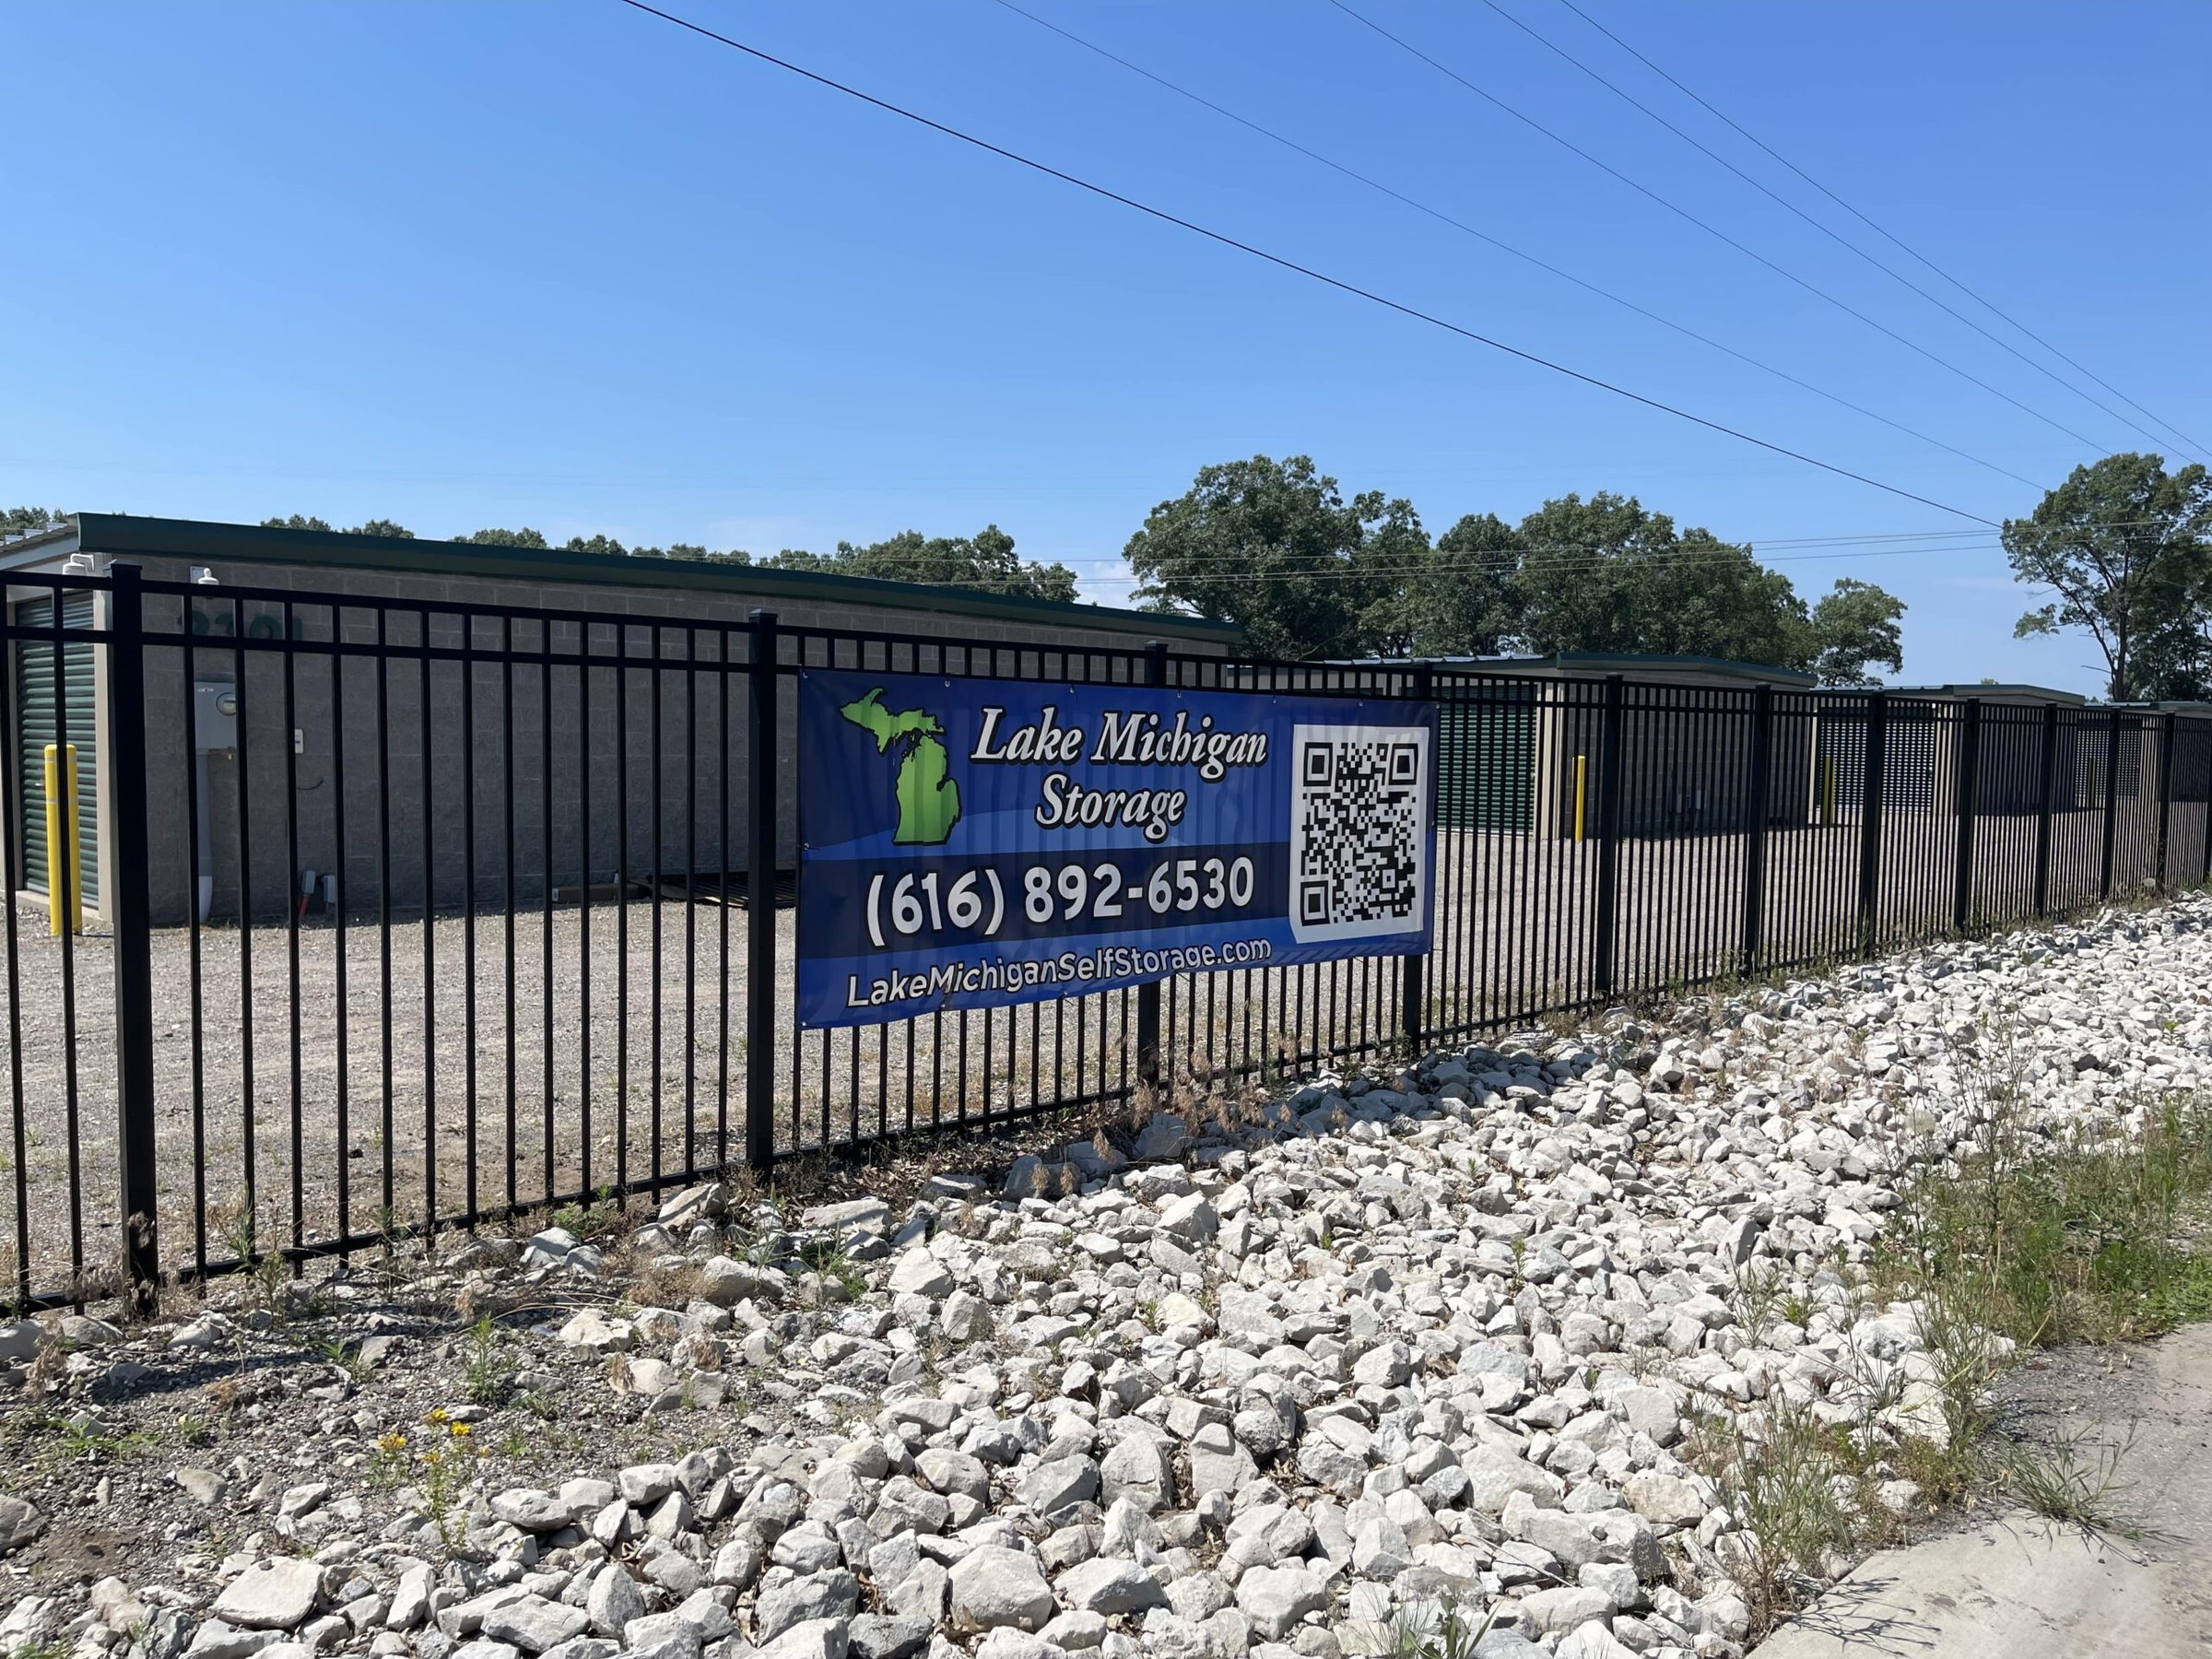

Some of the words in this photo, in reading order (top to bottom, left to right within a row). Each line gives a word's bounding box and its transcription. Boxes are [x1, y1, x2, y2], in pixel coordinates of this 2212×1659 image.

[970, 706, 1083, 761] Lake
[1089, 711, 1267, 780] Michigan
[1035, 772, 1186, 841] Storage
[865, 868, 1006, 947] (616)
[1023, 855, 1255, 924] 892-6530
[845, 935, 1273, 1008] LakeMichiganSelfStorage.com
